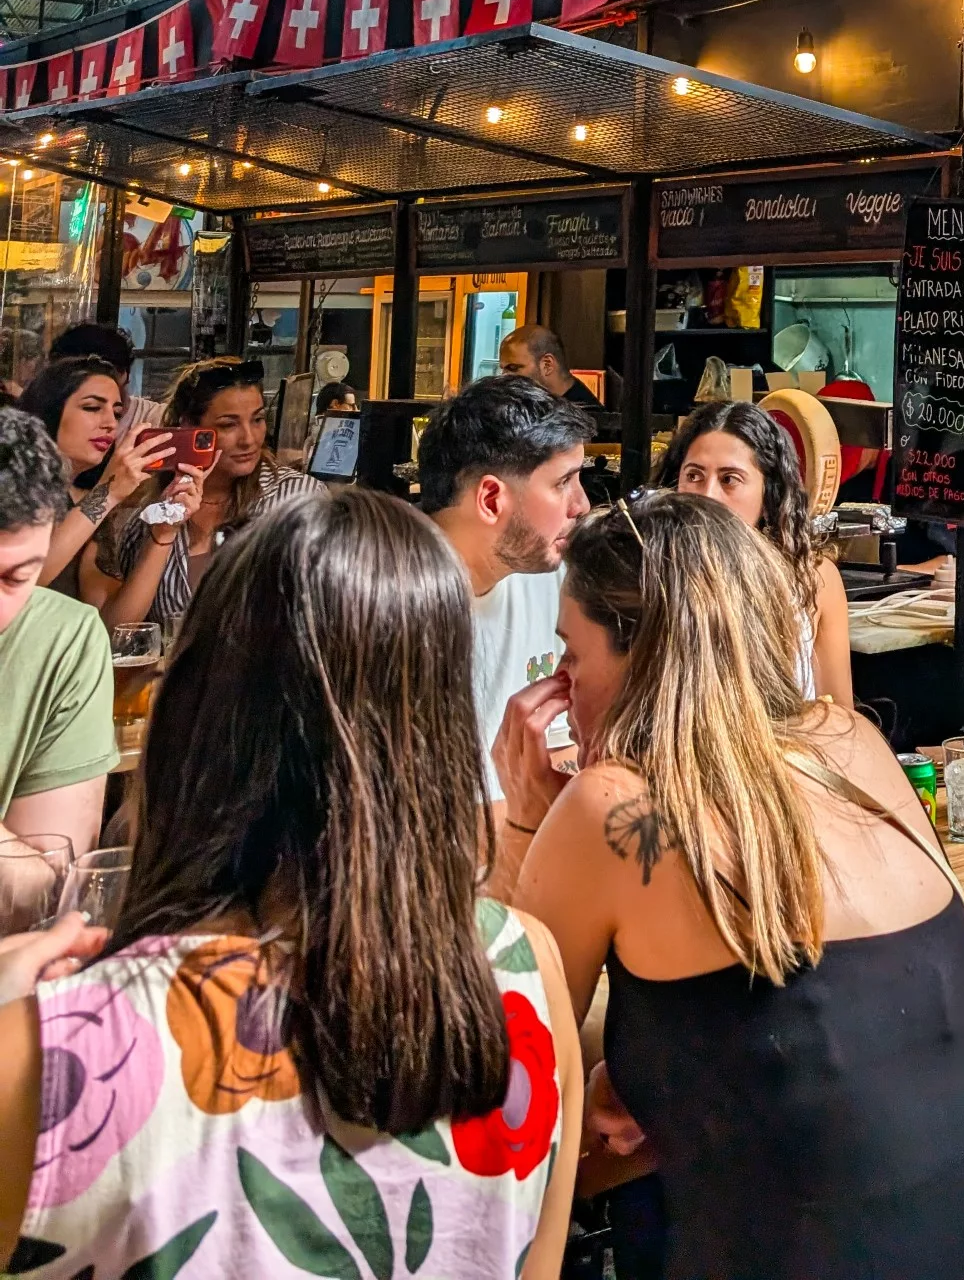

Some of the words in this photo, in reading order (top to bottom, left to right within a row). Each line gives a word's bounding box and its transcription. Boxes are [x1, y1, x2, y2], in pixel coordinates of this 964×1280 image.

[746, 193, 810, 222] Bondiola
[846, 189, 902, 223] Veggie
[546, 211, 591, 243] Funghi
[909, 245, 927, 268] JE
[930, 247, 962, 272] SUIS
[903, 310, 939, 329] PLATO
[905, 368, 928, 385] CON
[923, 471, 951, 485] OTROS
[929, 486, 939, 499] DE
